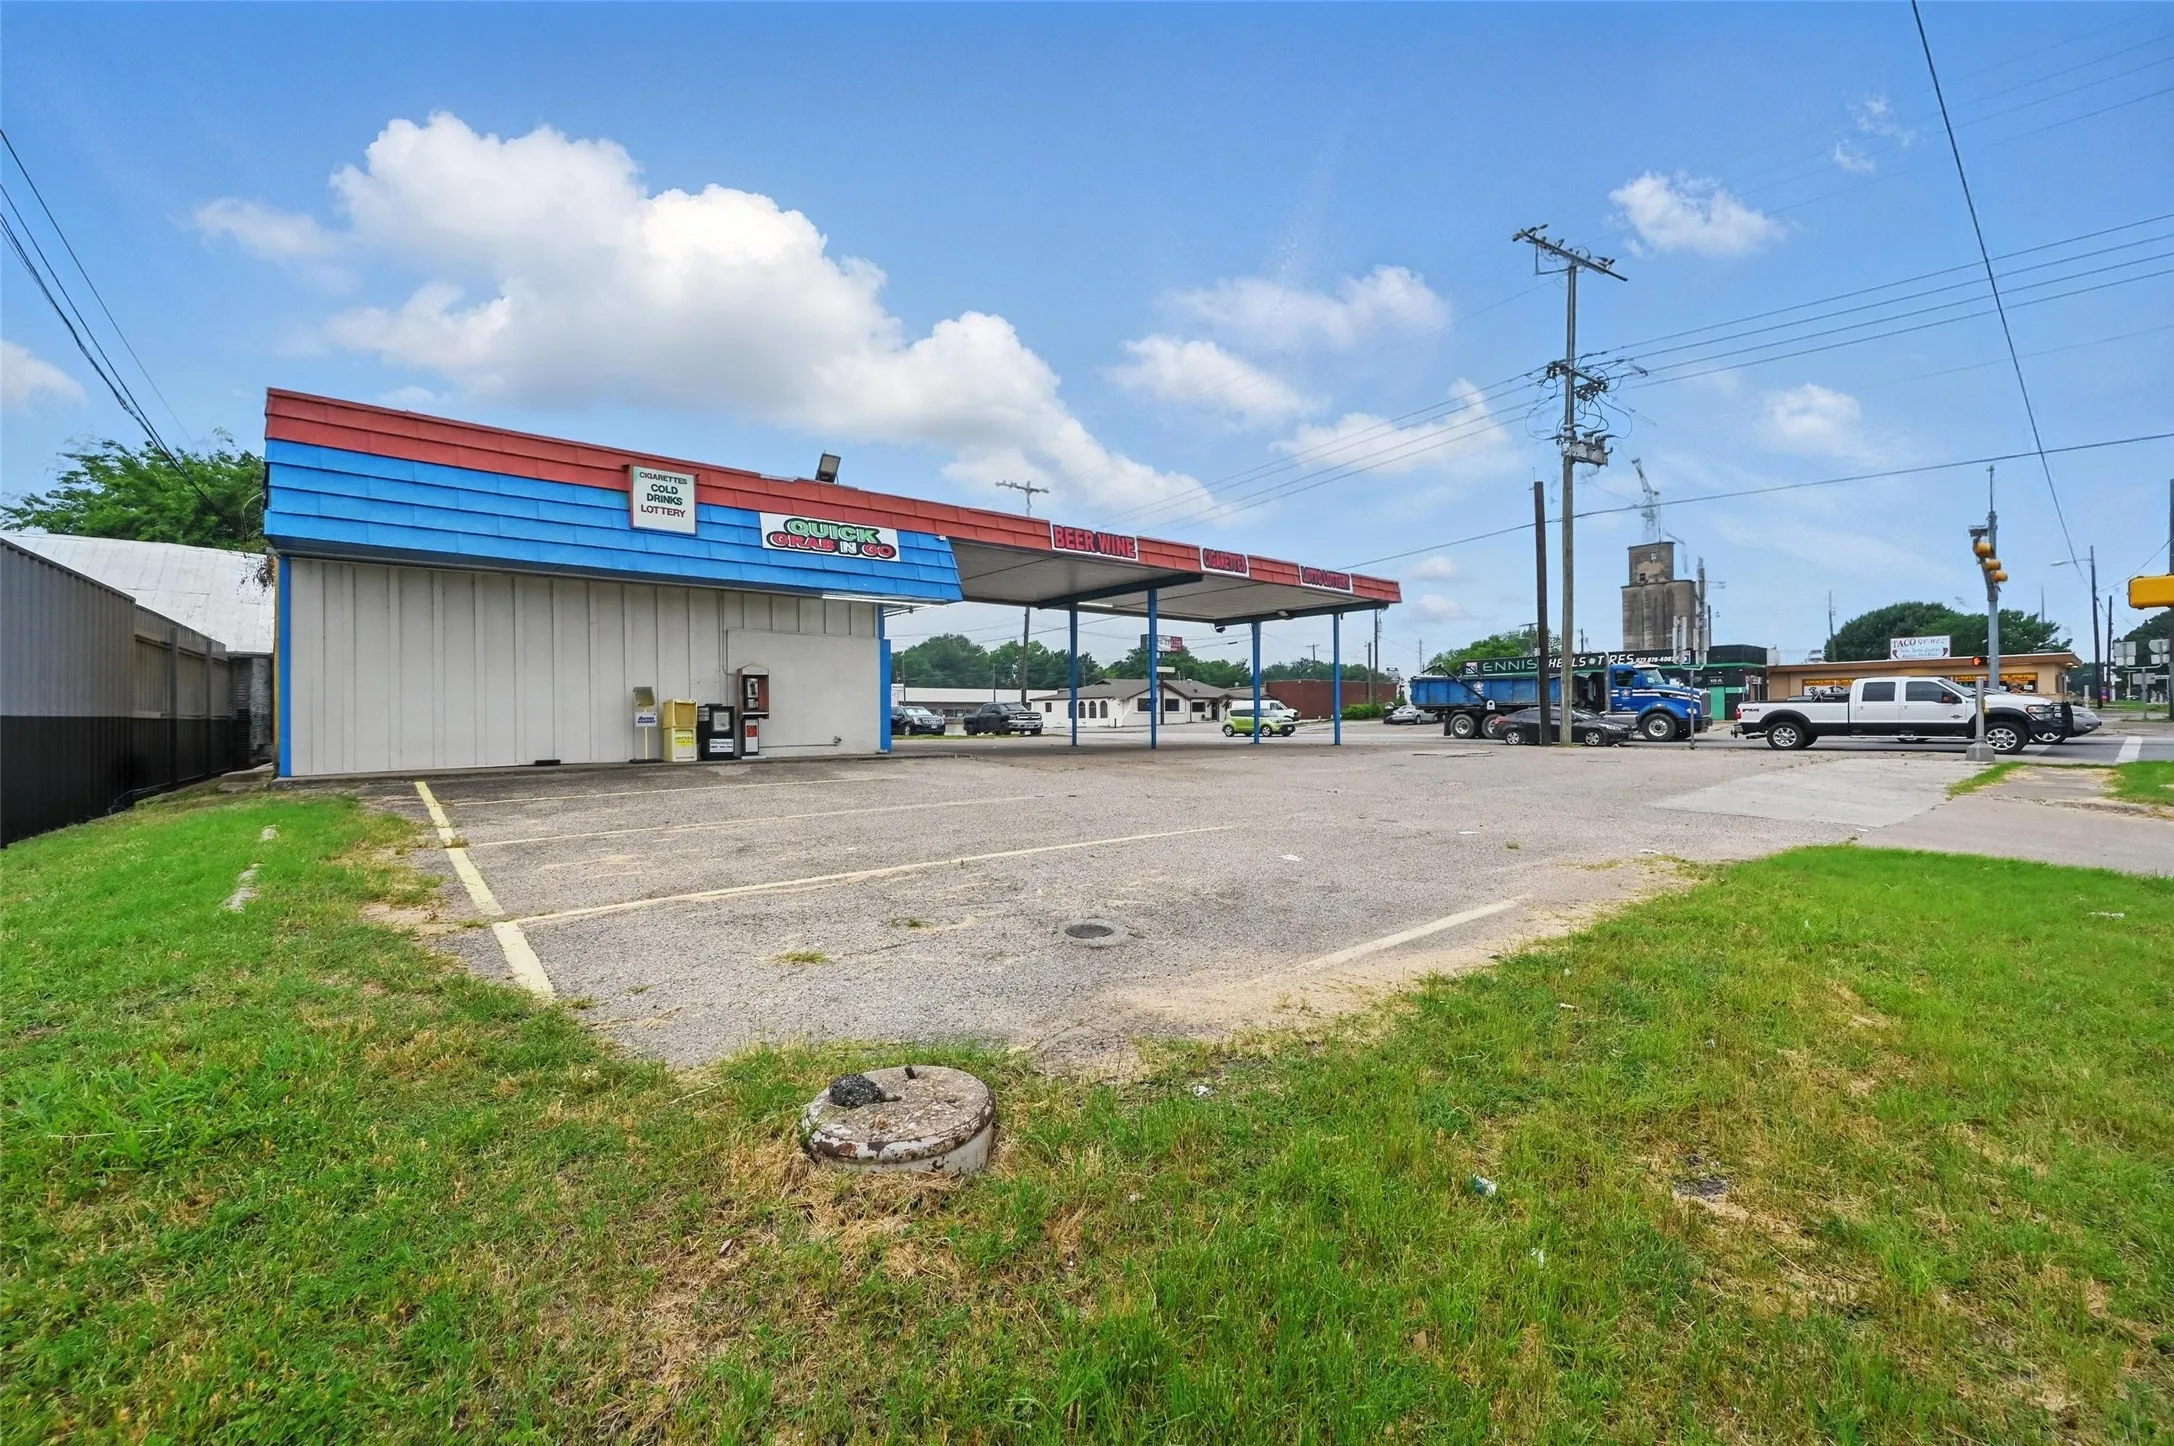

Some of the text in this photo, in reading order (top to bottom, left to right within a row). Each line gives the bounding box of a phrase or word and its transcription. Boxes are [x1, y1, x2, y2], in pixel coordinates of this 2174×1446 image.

[639, 471, 688, 485] CIGARETTES
[651, 483, 679, 495] COLD
[646, 493, 683, 506] DRINKS
[640, 504, 686, 518] LOTTERY
[785, 519, 880, 544] QUICK
[768, 532, 896, 559] GRAB N GO
[1053, 525, 1136, 558] BEER WINE
[1203, 548, 1247, 573] CIGARETTES
[1892, 638, 1917, 648] TACO
[1482, 659, 1538, 672] ENNIS
[1547, 656, 1587, 668] HELS
[1597, 653, 1636, 666] TRES
